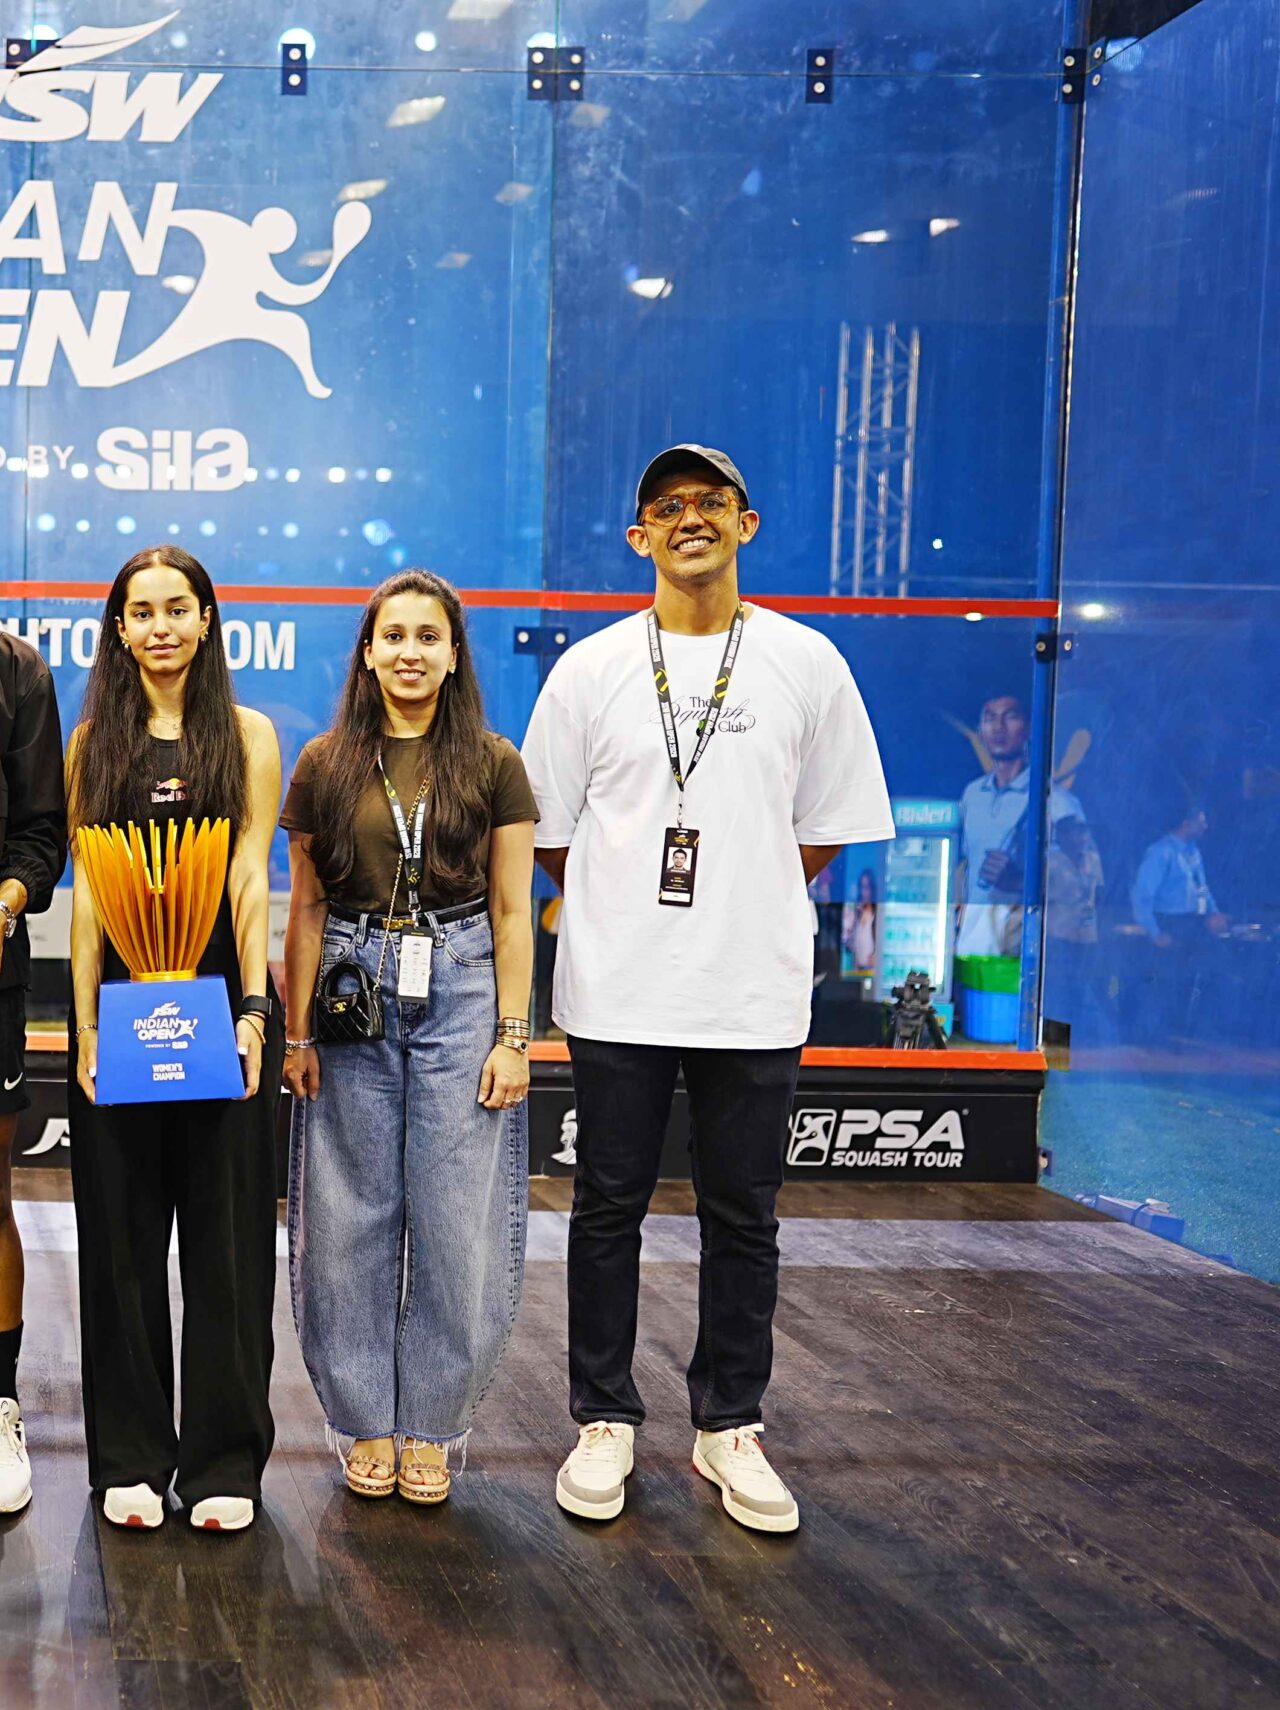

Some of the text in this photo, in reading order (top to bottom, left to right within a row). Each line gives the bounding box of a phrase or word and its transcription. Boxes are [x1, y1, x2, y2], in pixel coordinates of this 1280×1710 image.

[27, 445, 75, 470] BY
[95, 426, 249, 492] Sila
[718, 721, 747, 733] Club
[151, 790, 175, 803] Red
[133, 1018, 179, 1030] INDIAN
[138, 1029, 176, 1040] OPEN
[153, 1072, 185, 1080] CHAMPION
[835, 1109, 965, 1150] PSA
[831, 1151, 963, 1168] SQUASH TOUR
